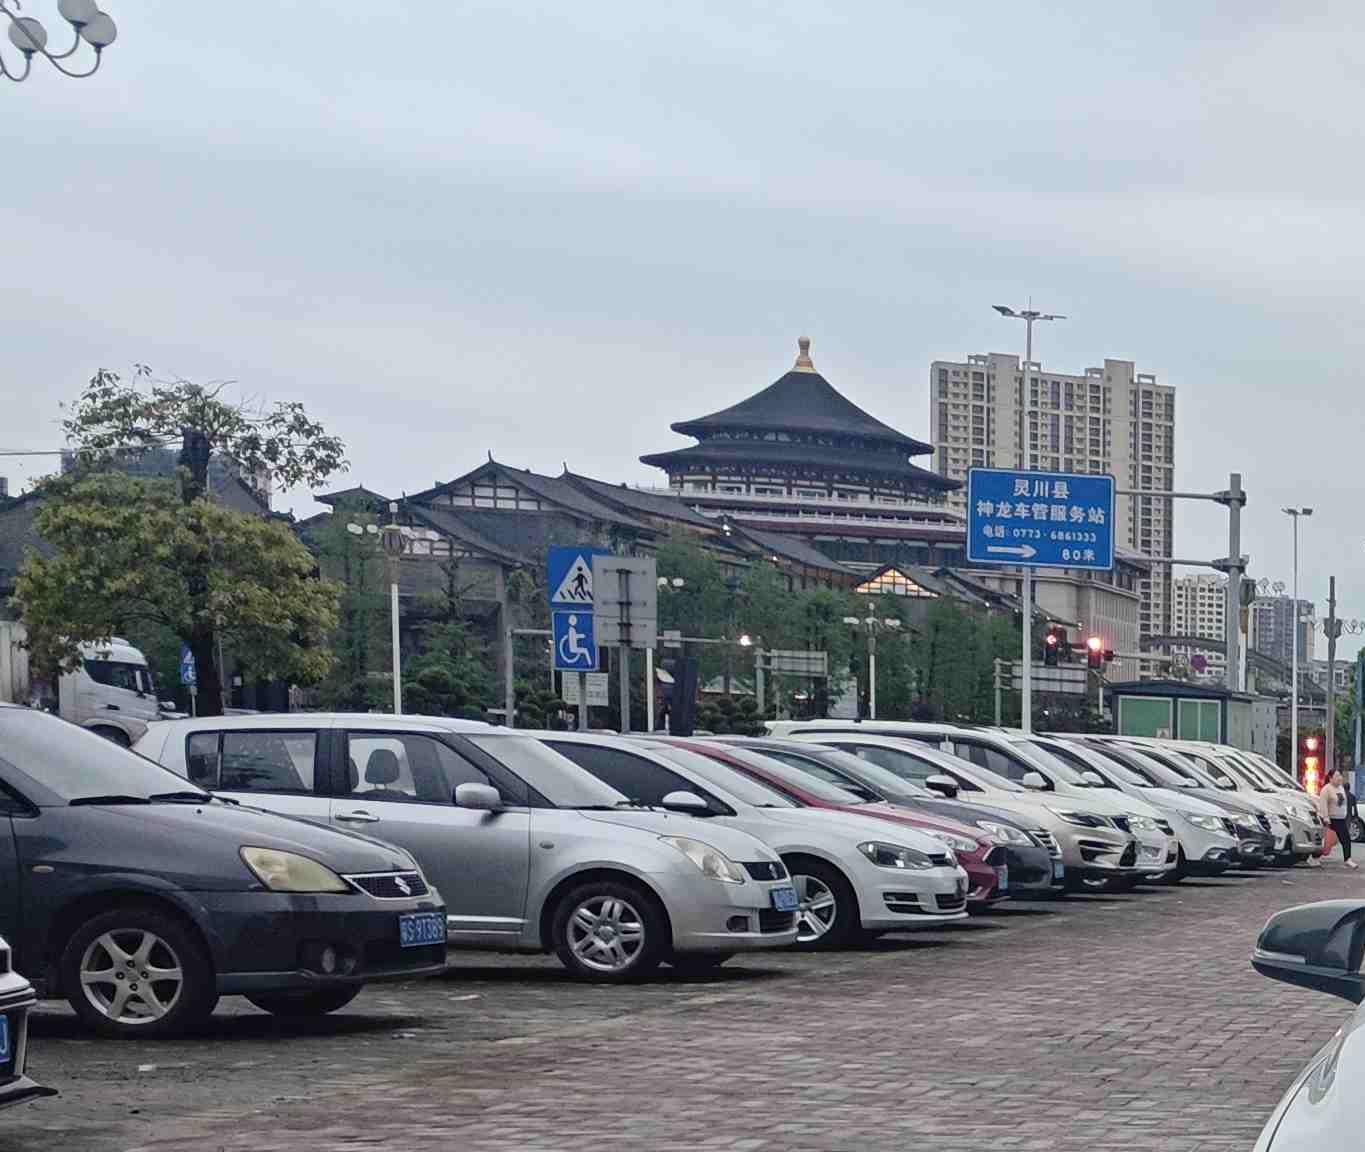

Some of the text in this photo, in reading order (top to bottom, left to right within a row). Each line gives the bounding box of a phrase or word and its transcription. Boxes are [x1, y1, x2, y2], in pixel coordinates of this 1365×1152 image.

[1013, 479, 1070, 498] 灵川县
[976, 500, 1105, 524] 神龙车管服务站
